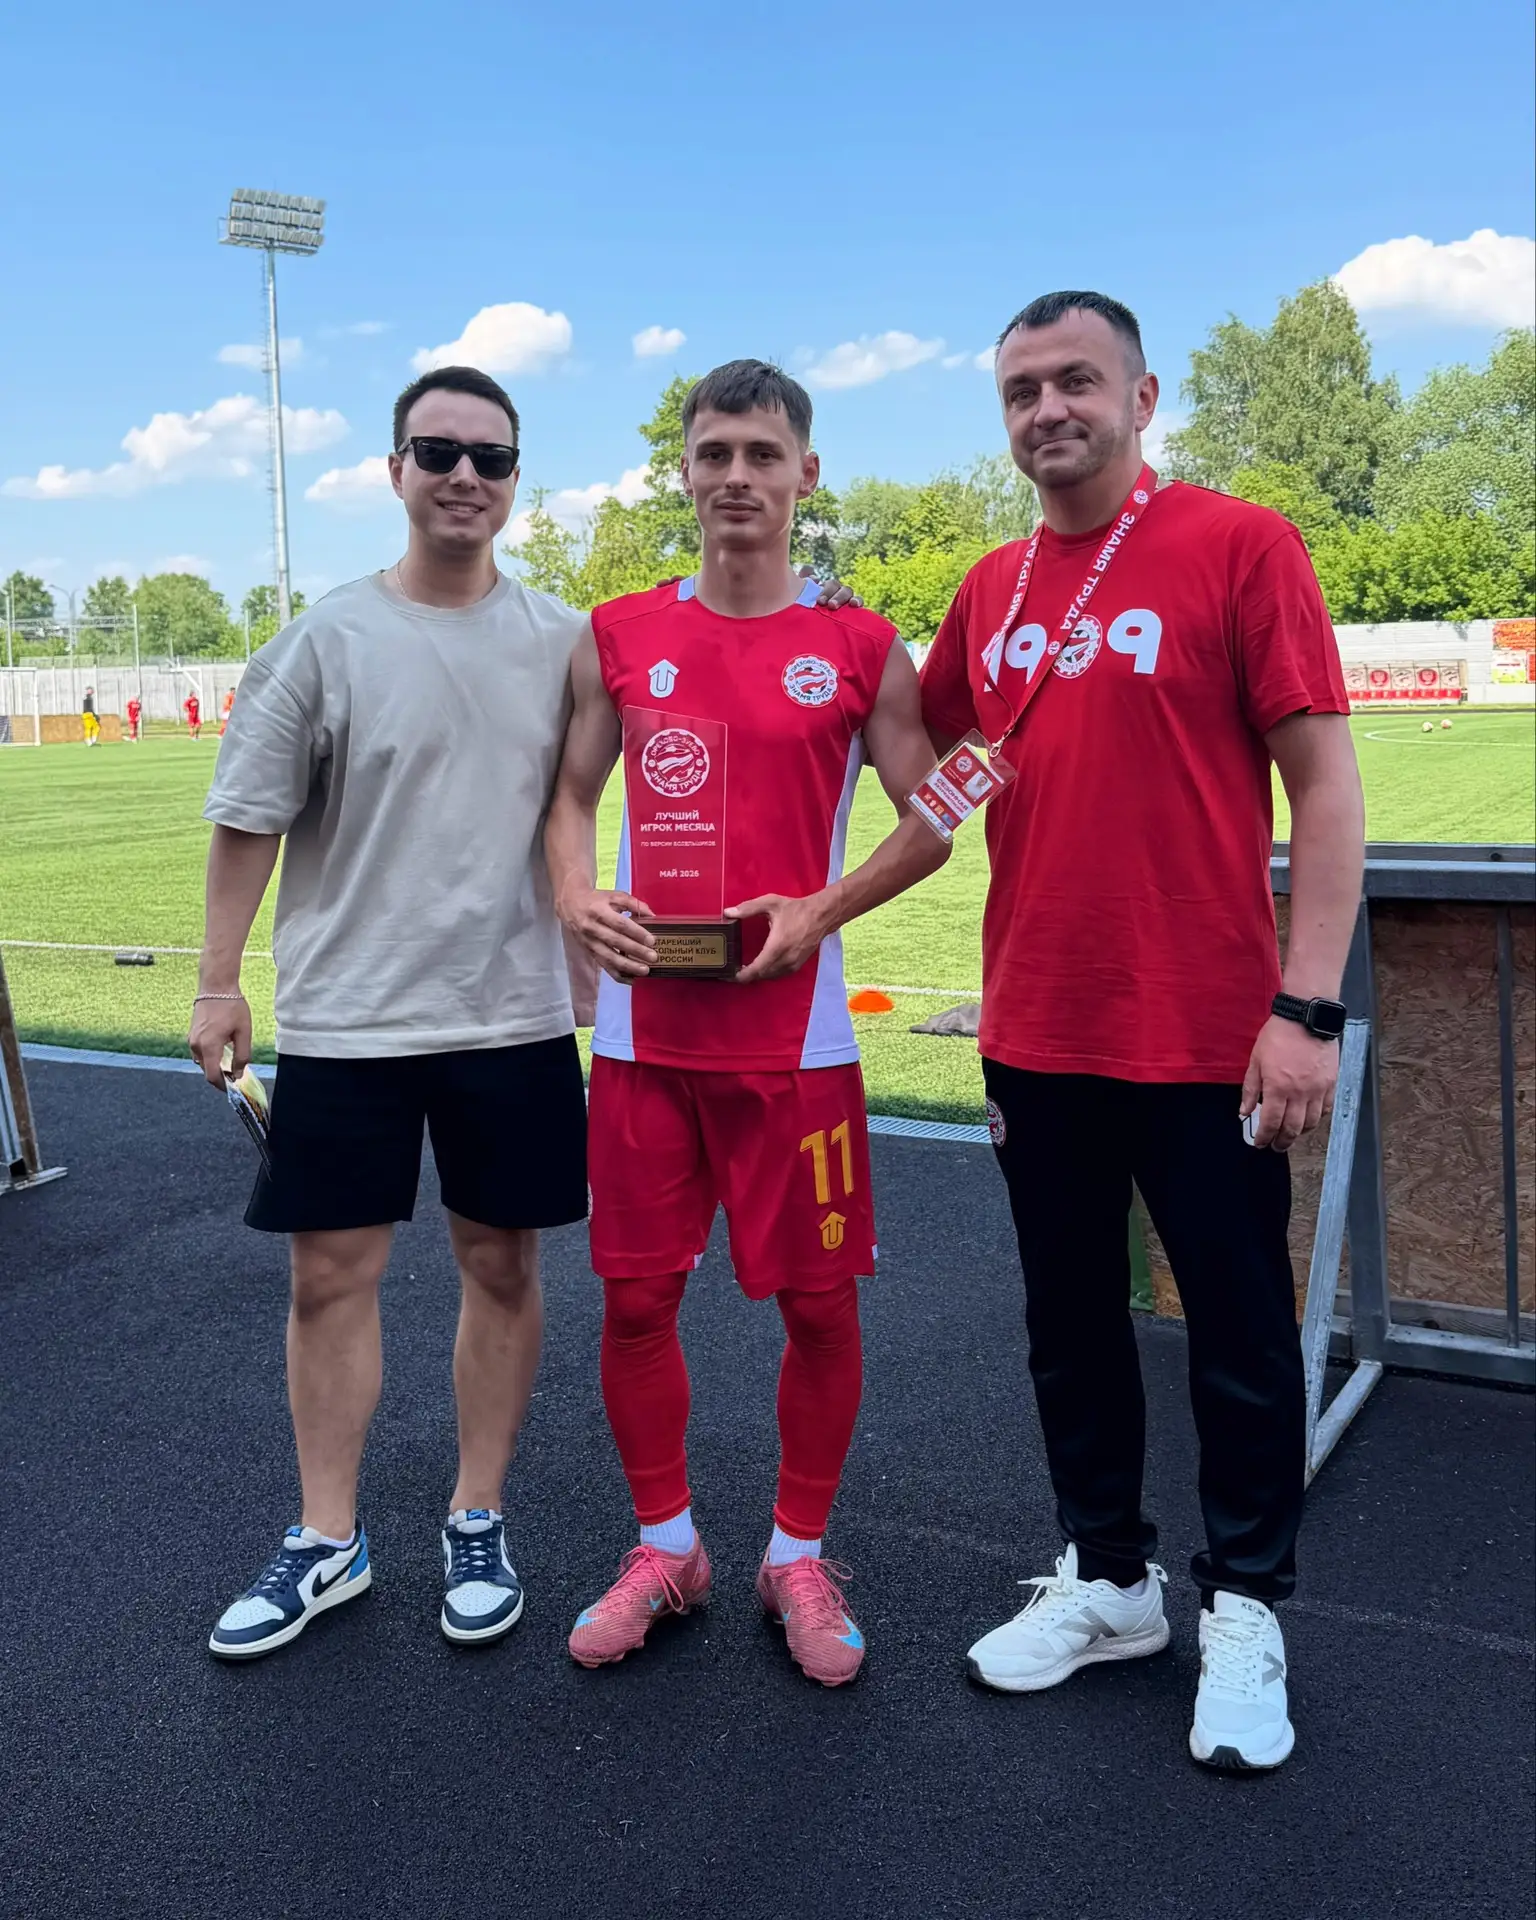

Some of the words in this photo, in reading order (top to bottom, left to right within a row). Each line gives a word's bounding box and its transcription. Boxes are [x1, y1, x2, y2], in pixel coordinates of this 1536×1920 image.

[1093, 512, 1135, 572] ЗНАМЯ
[1016, 536, 1039, 591] ТРУДА
[1060, 576, 1100, 630] ТРУДА
[789, 684, 811, 700] ЗНАМЯ
[813, 688, 832, 701] ТРУДА
[651, 736, 700, 755] ОРЕХОВО-ЗУЕВО
[651, 771, 677, 790] ЗНАМЯ
[679, 770, 702, 790] ТРУДА
[655, 810, 699, 820] ЛУЧШИЙ
[640, 823, 673, 832] ИГРОК
[674, 823, 715, 832] МЕСЯЦА
[659, 868, 678, 878] МАЙ
[680, 869, 700, 878] 2026
[660, 955, 694, 963] РОССИИ
[695, 947, 717, 955] КЛУБ
[800, 1119, 855, 1205] 11
